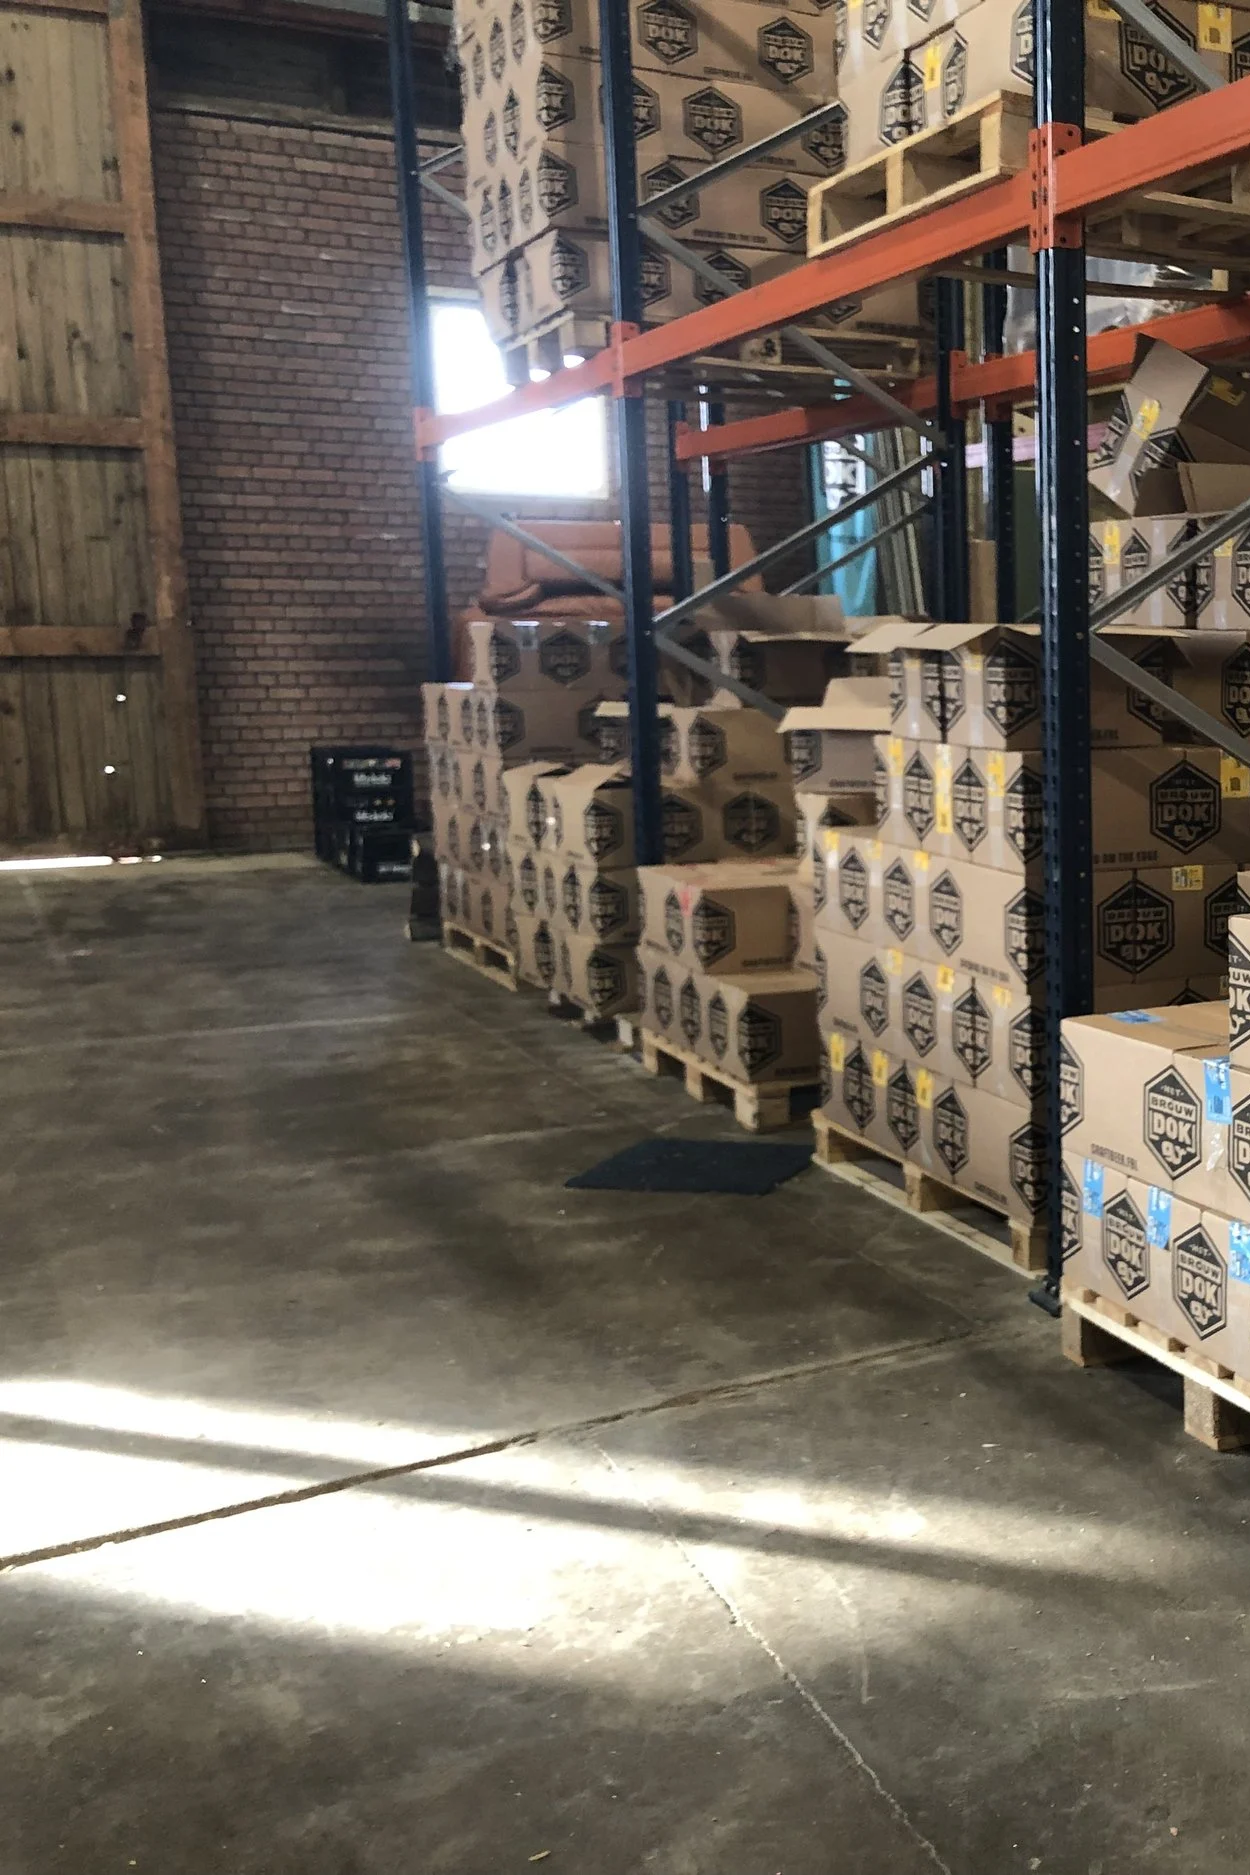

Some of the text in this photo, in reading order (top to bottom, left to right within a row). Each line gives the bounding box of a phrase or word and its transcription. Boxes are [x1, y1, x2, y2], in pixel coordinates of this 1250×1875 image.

[1164, 803, 1206, 823] DOK
[1153, 1112, 1192, 1144] DOK
[1182, 1270, 1218, 1307] DOK
